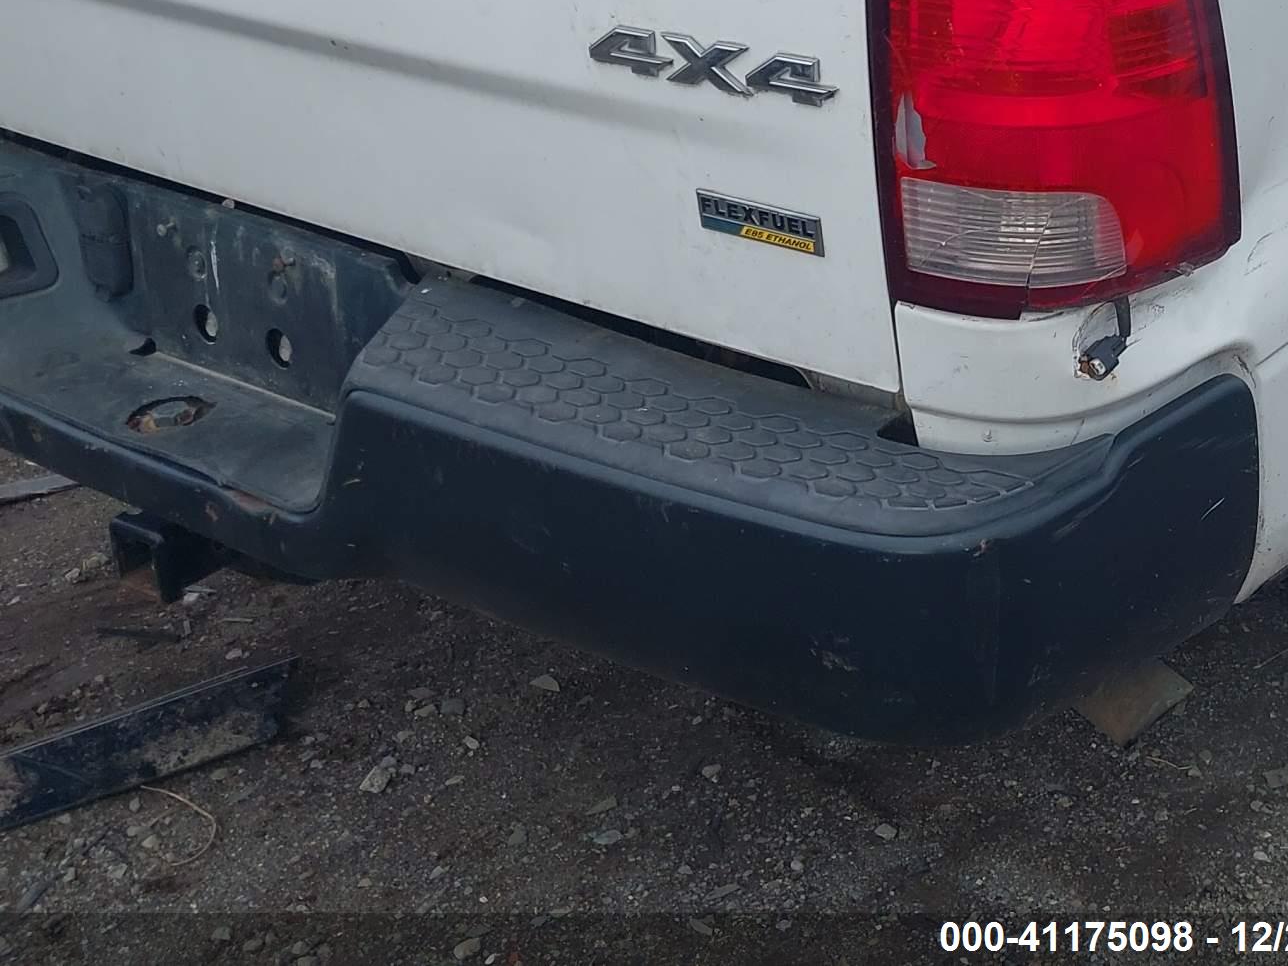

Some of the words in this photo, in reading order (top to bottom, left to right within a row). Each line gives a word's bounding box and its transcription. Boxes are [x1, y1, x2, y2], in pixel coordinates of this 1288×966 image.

[700, 195, 816, 239] FLEXFUEL
[744, 228, 763, 240] E85
[765, 234, 812, 251] ETHANOL
